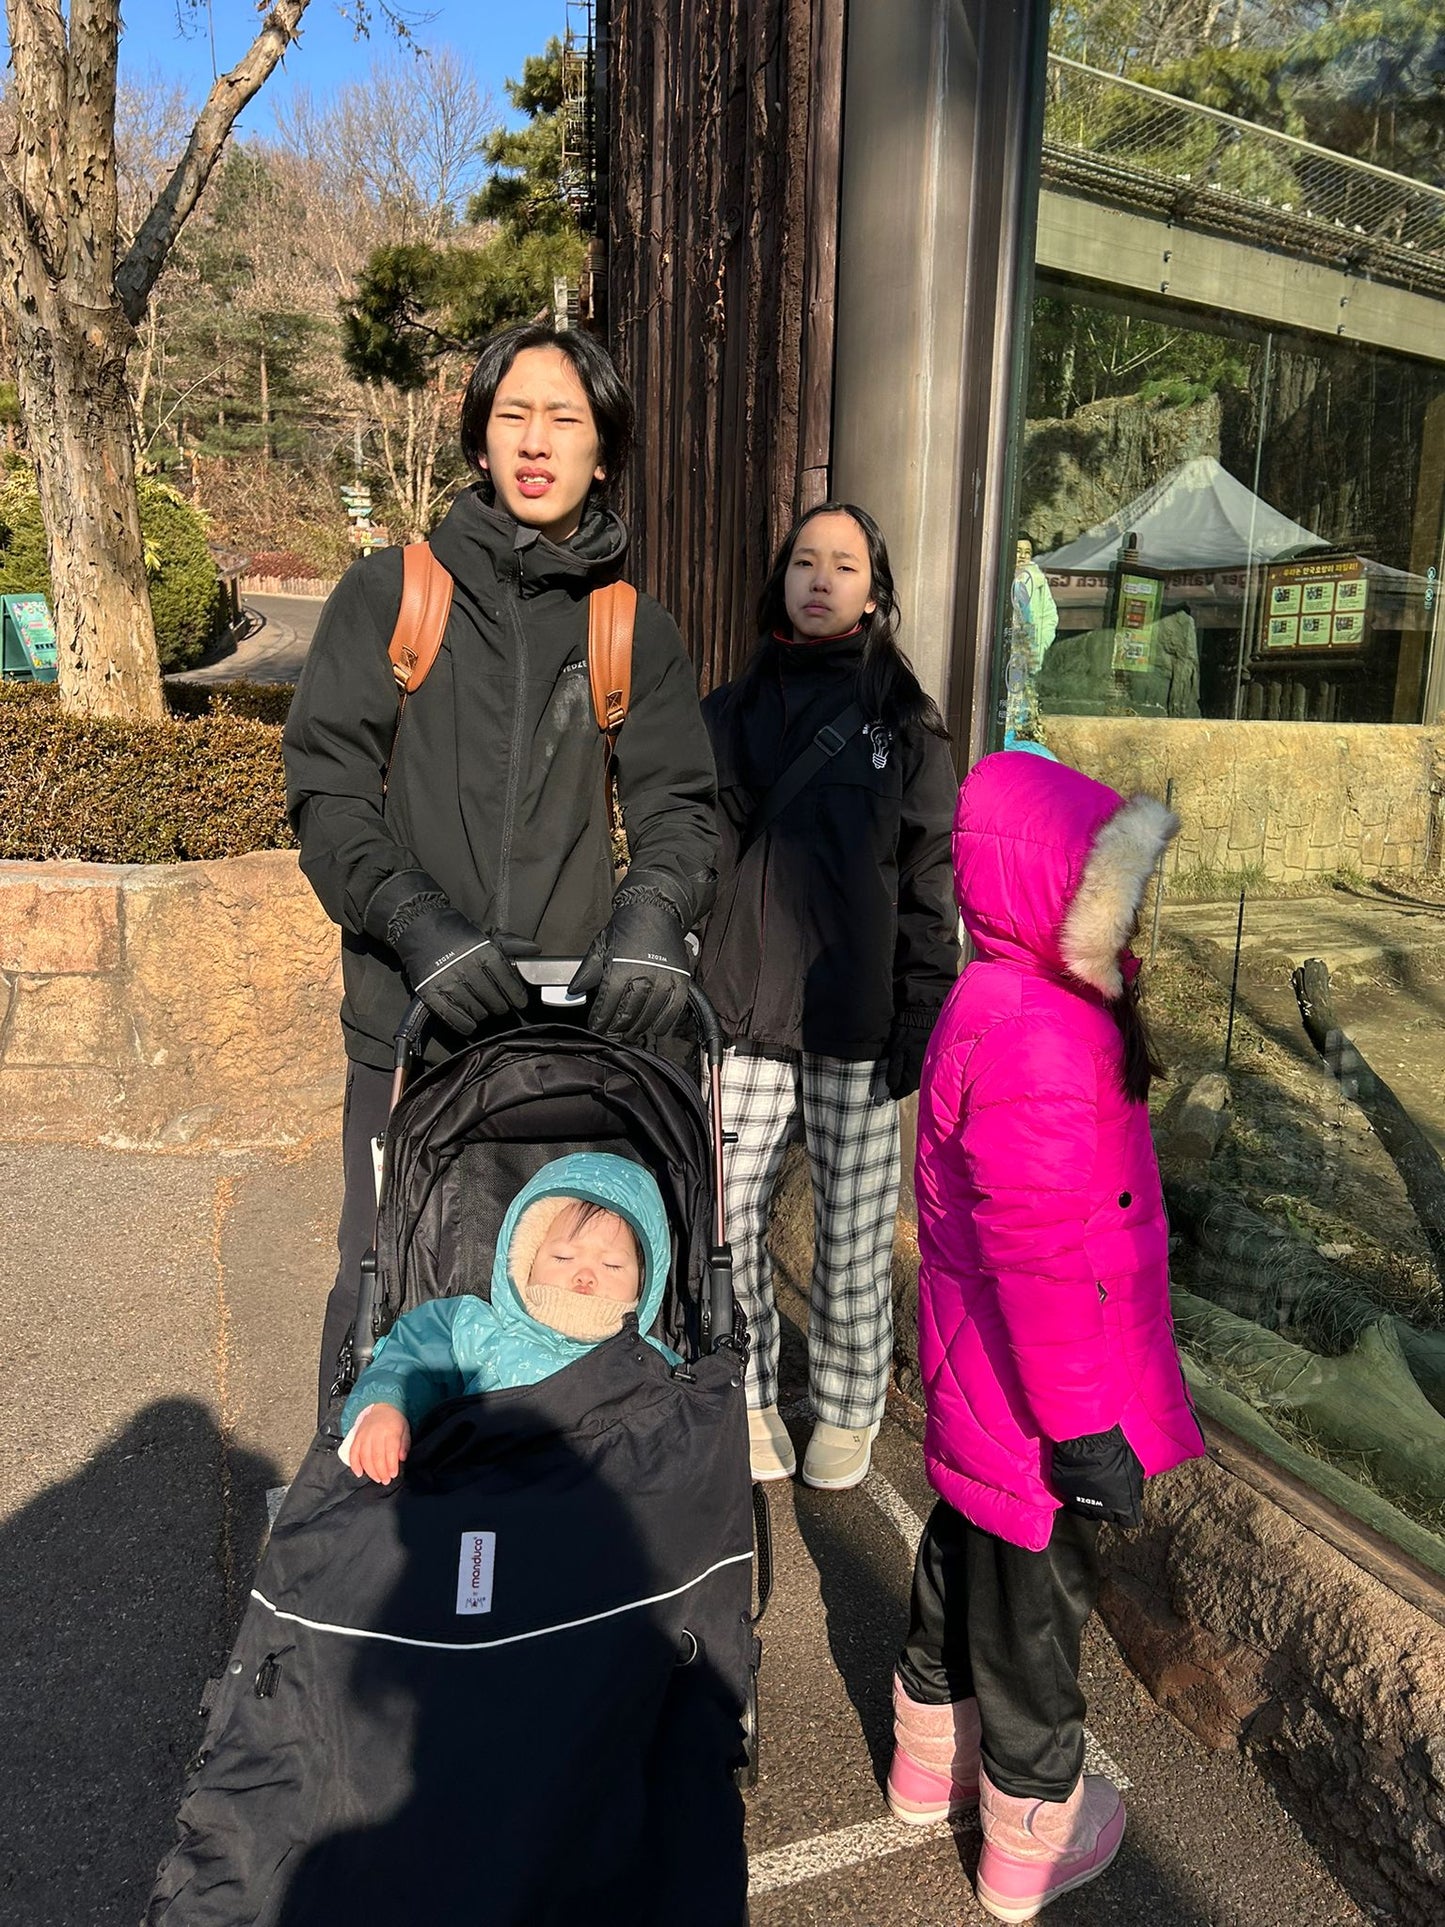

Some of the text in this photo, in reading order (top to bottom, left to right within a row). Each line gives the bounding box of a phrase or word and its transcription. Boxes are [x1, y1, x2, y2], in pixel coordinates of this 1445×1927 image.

[435, 951, 456, 967] WEDZE
[647, 953, 668, 963] WEDZE
[1075, 1496, 1104, 1507] WEDZE
[472, 1538, 484, 1588] manduca
